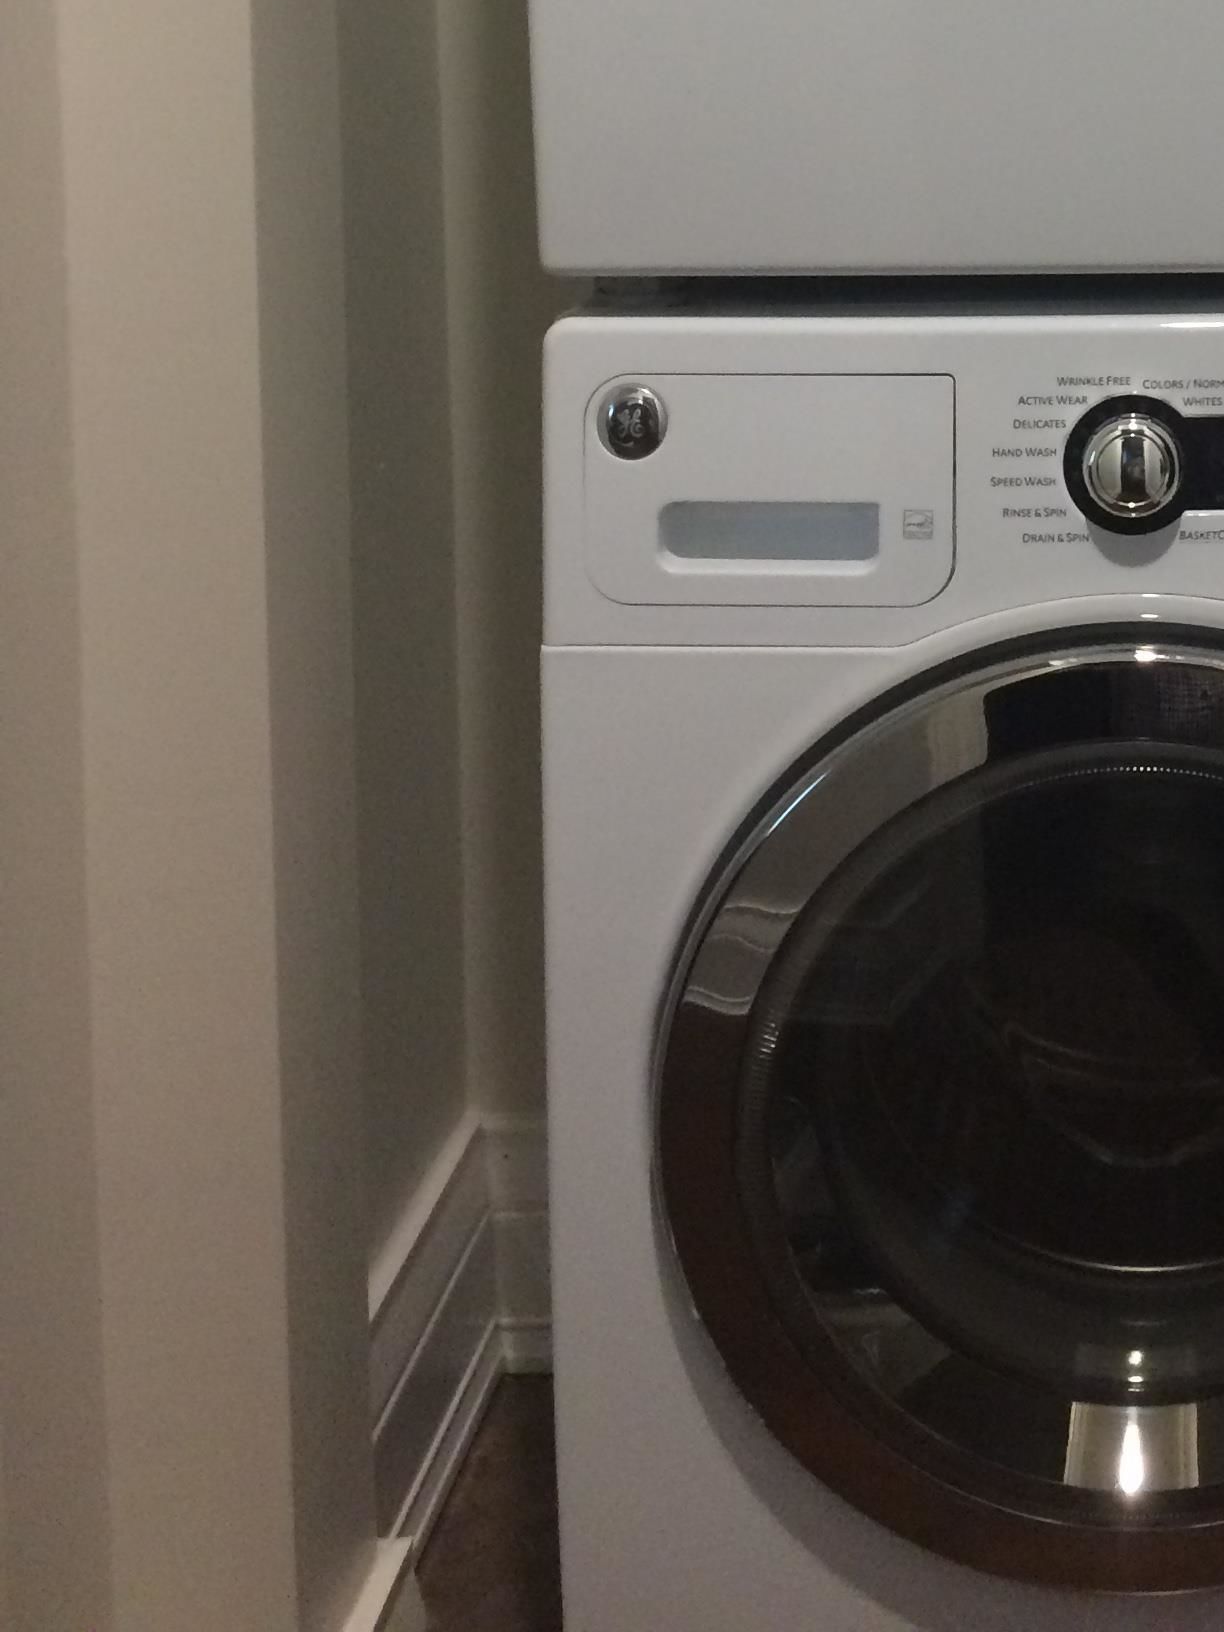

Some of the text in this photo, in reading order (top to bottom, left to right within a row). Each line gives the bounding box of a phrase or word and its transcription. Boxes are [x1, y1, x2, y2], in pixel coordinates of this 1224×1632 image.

[1056, 375, 1131, 386] WRINKLE FREE
[1142, 379, 1184, 390] COLORS
[1018, 395, 1088, 405] ACTIVE WEAR
[1182, 397, 1223, 406] WHITES
[1013, 419, 1067, 429] DELICATES
[992, 447, 1057, 457] HAND WASH
[990, 476, 1056, 487] SPEED WASH
[1002, 507, 1067, 518] RINSE & SPIN
[1022, 532, 1090, 543] DRAIN & SPIN
